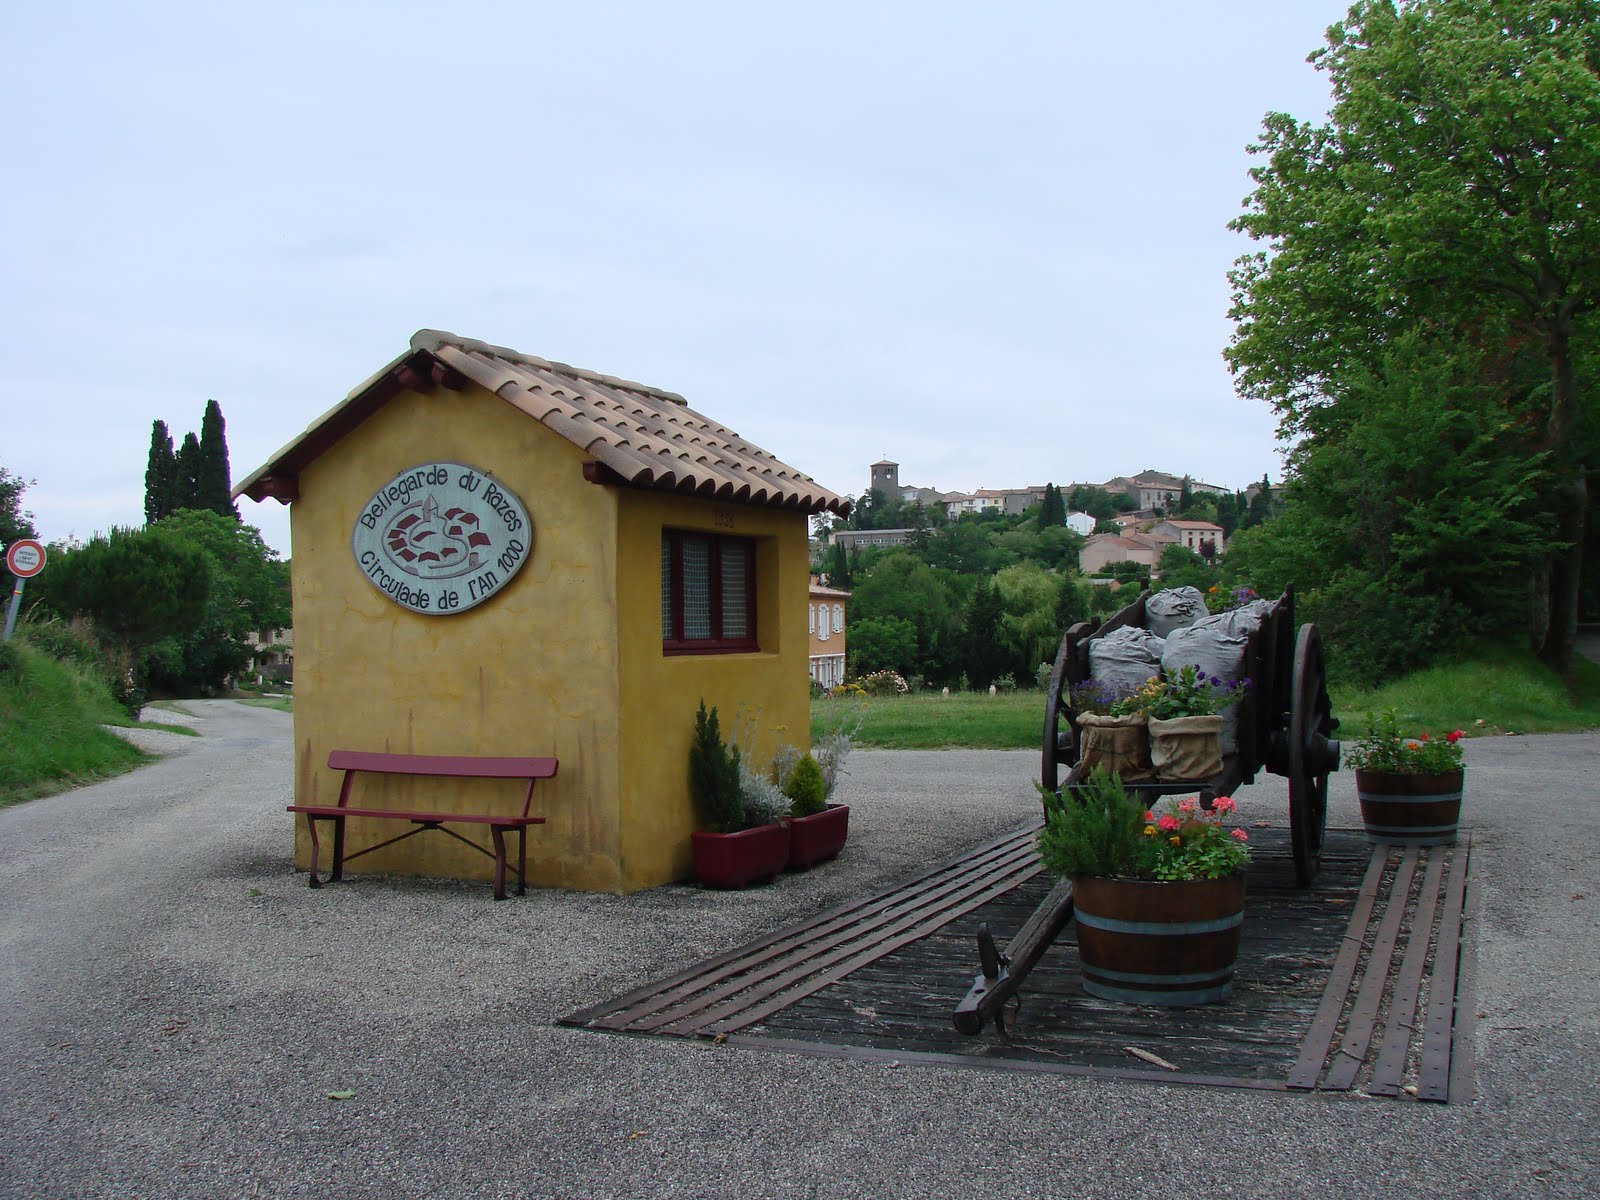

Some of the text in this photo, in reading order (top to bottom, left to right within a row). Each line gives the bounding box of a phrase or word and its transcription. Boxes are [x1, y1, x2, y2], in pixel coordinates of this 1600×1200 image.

[361, 466, 522, 532] Bellegarde du Razes
[361, 551, 430, 609] Circulade
[438, 590, 459, 609] de
[497, 539, 524, 574] 1000
